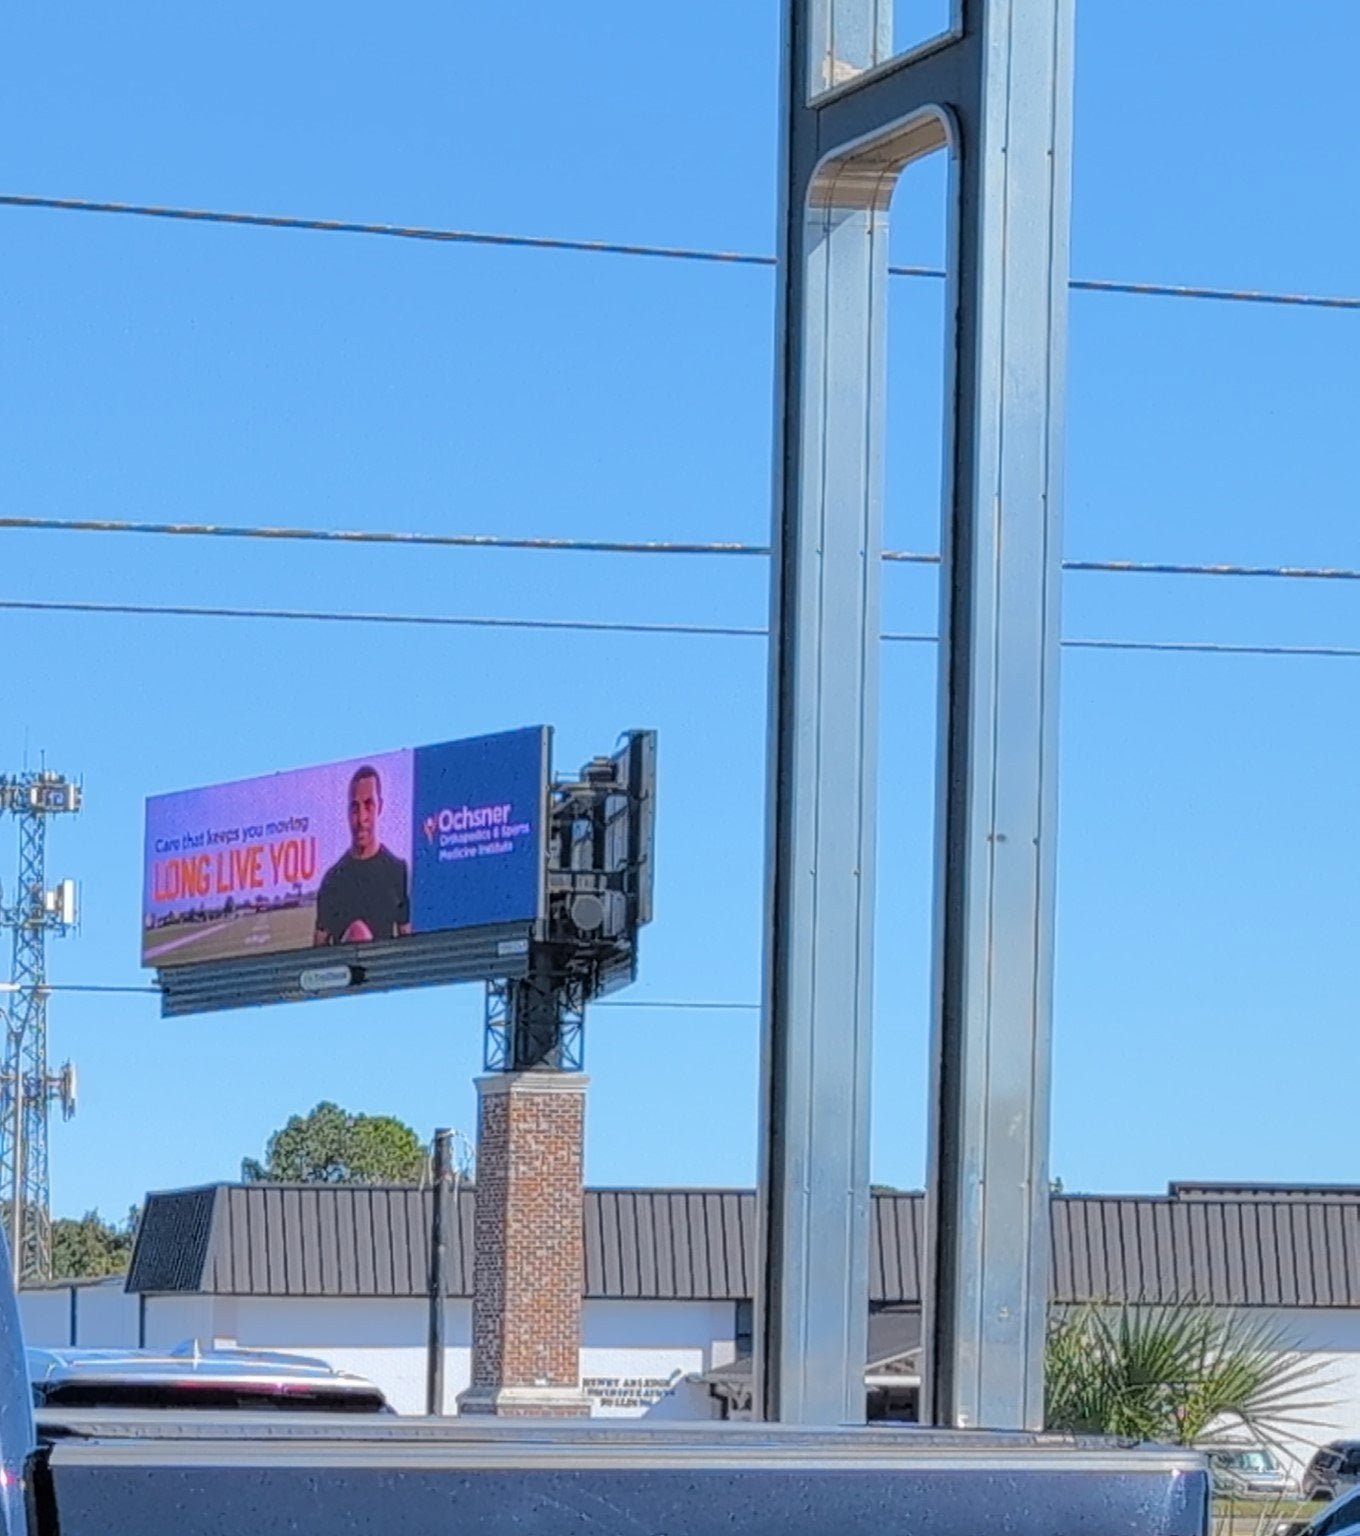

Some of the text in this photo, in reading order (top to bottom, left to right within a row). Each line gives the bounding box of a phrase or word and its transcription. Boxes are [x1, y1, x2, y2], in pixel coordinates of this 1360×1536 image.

[439, 804, 512, 833] Ochsner
[182, 832, 205, 848] that
[207, 828, 240, 846] keeps
[242, 824, 264, 842] you
[153, 836, 316, 902] LONG LIVE YOU
